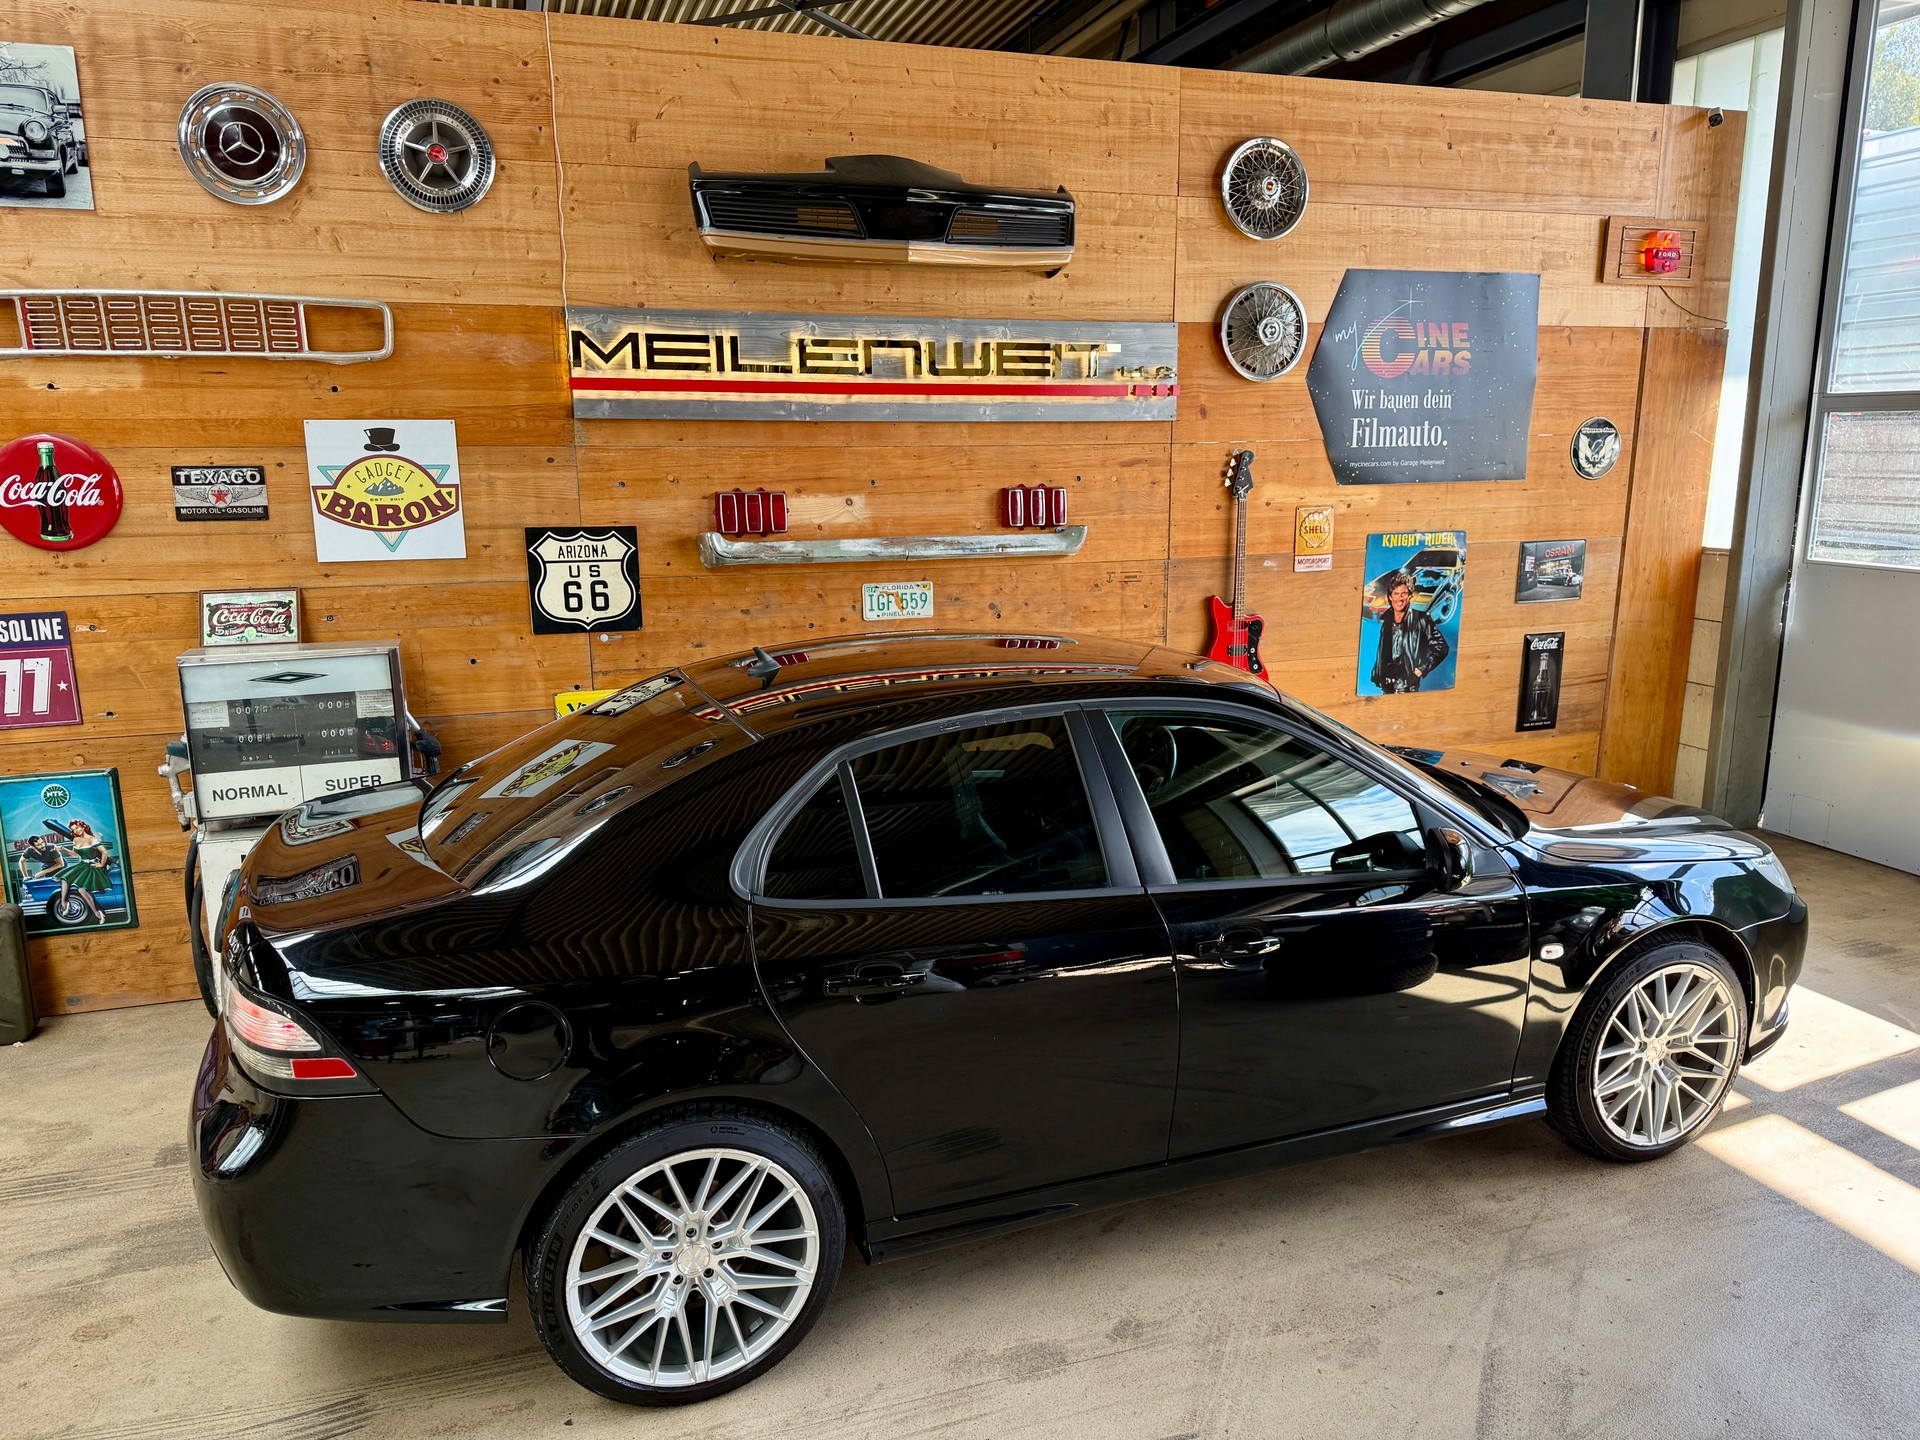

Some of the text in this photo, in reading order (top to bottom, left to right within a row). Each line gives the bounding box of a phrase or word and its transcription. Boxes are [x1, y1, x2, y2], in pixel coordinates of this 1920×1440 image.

[571, 330, 1121, 378] MEILENWEIT
[1352, 389, 1452, 409] Wir bauen dein
[1351, 418, 1448, 448] Filmauto.
[354, 462, 415, 484] GADGET
[1349, 460, 1391, 468] mycinecars.com
[176, 470, 261, 484] TEXACO
[323, 489, 455, 527] BARON
[1382, 532, 1456, 548] KNIGHT RIDER
[558, 544, 608, 559] ARIZONA
[1544, 543, 1575, 558] OSRAM
[1297, 557, 1329, 565] MOTORSPORT
[563, 580, 610, 612] 66
[212, 606, 289, 626] Coca-Cola
[1530, 637, 1559, 650] Coca-Cola
[212, 784, 288, 801] NORMAL
[325, 775, 382, 792] SUPER
[1581, 1000, 1608, 1066] MICHELIN
[543, 1236, 563, 1323] MICHELIN
